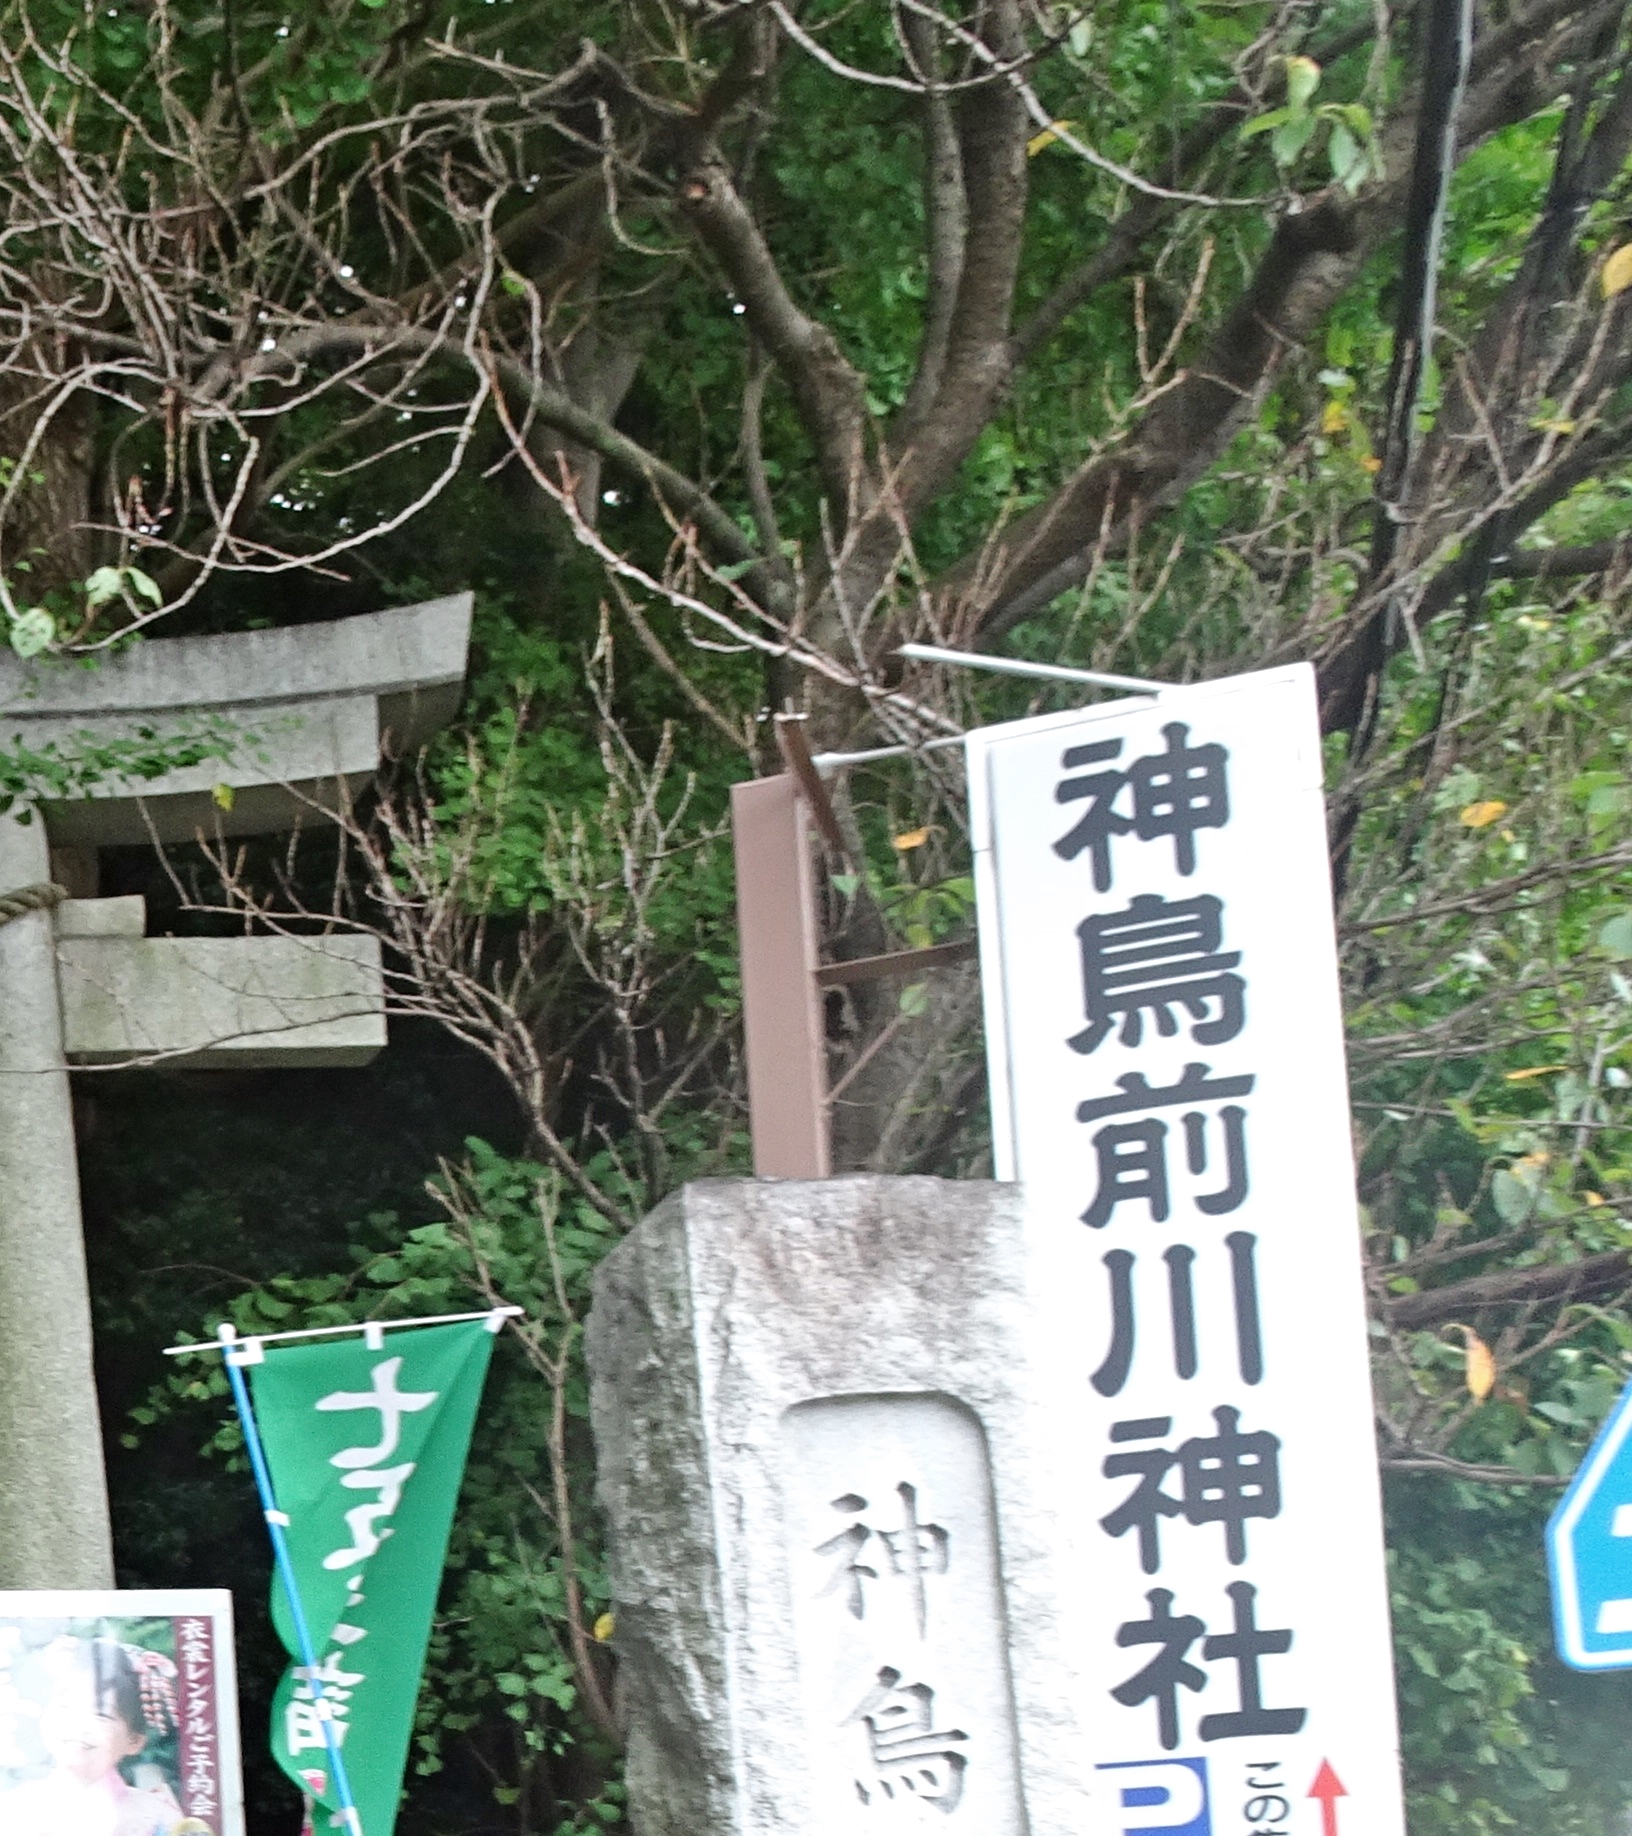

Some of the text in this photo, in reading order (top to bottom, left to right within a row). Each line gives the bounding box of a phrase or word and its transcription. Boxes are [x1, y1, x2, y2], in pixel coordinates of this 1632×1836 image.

[1054, 722, 1306, 1751] 神鳥前川神社
